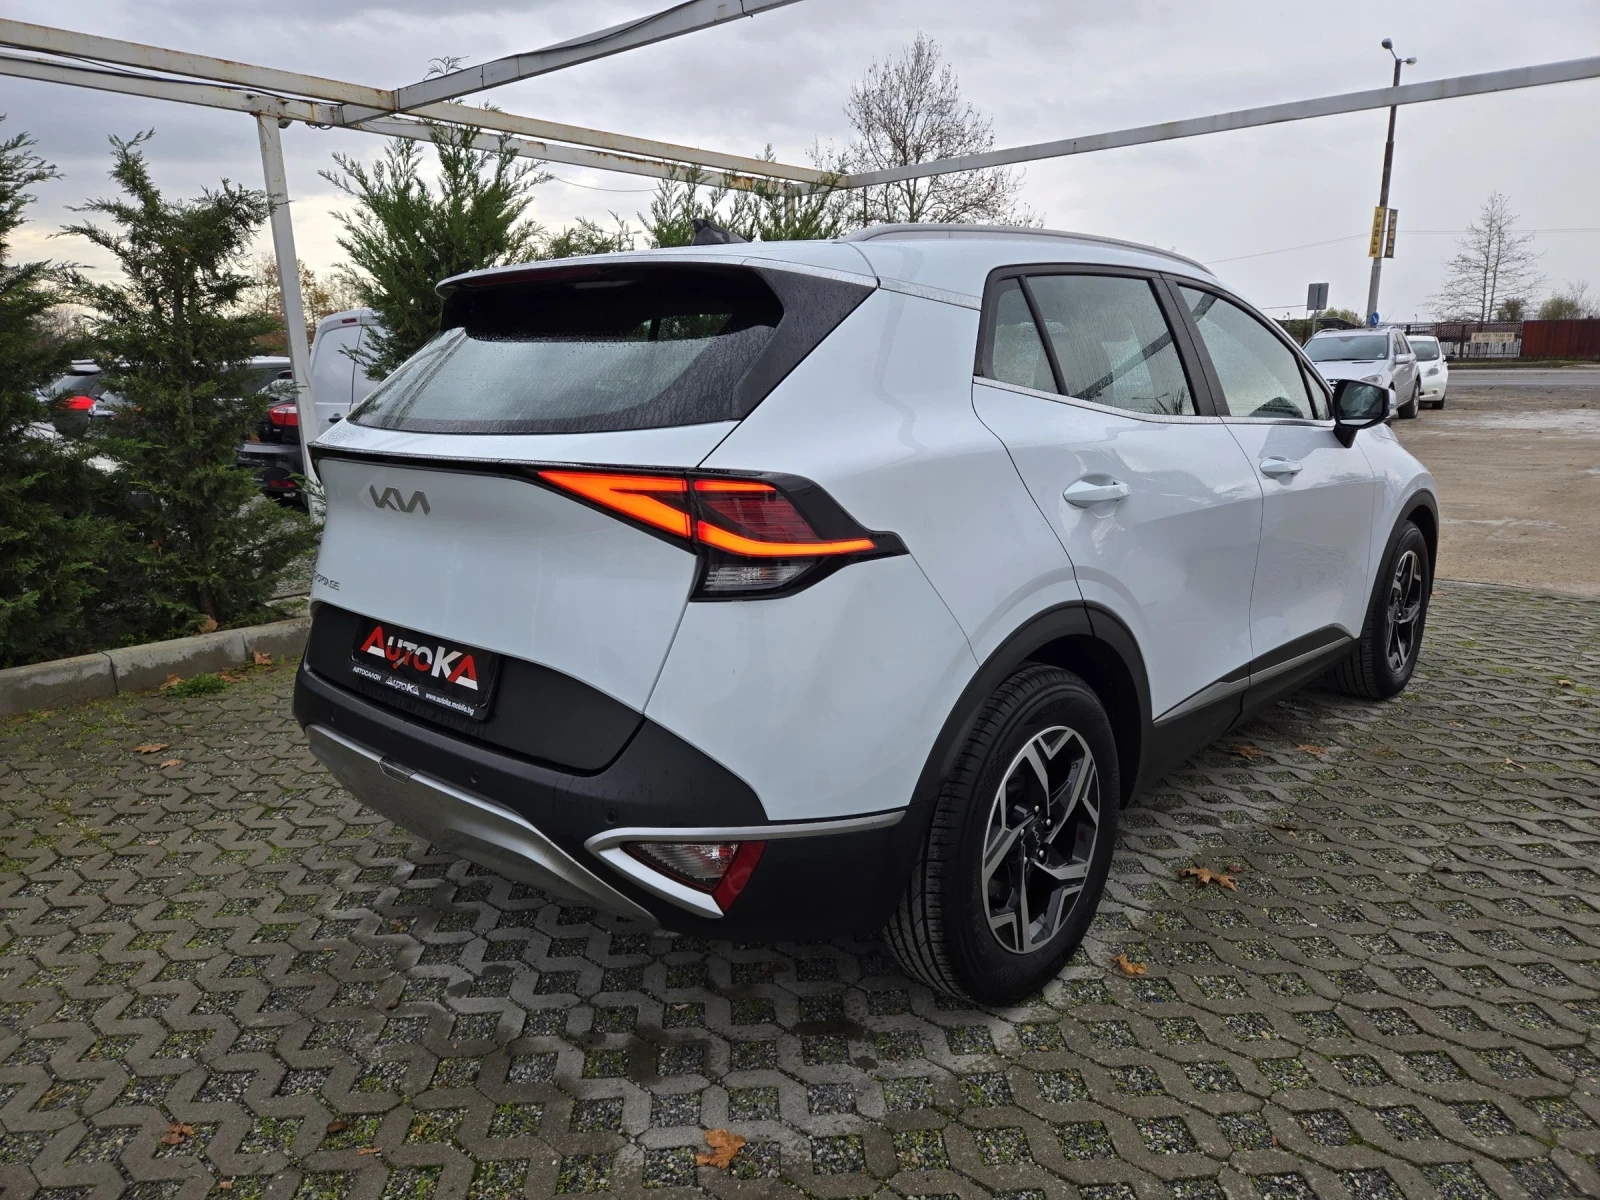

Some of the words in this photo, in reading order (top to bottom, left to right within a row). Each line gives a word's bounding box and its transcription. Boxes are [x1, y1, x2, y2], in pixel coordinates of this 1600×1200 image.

[368, 483, 431, 516] KIA
[360, 625, 479, 691] AUTOKA
[352, 665, 381, 681] АВТОСАЛОН
[385, 676, 420, 696] AUTOKA
